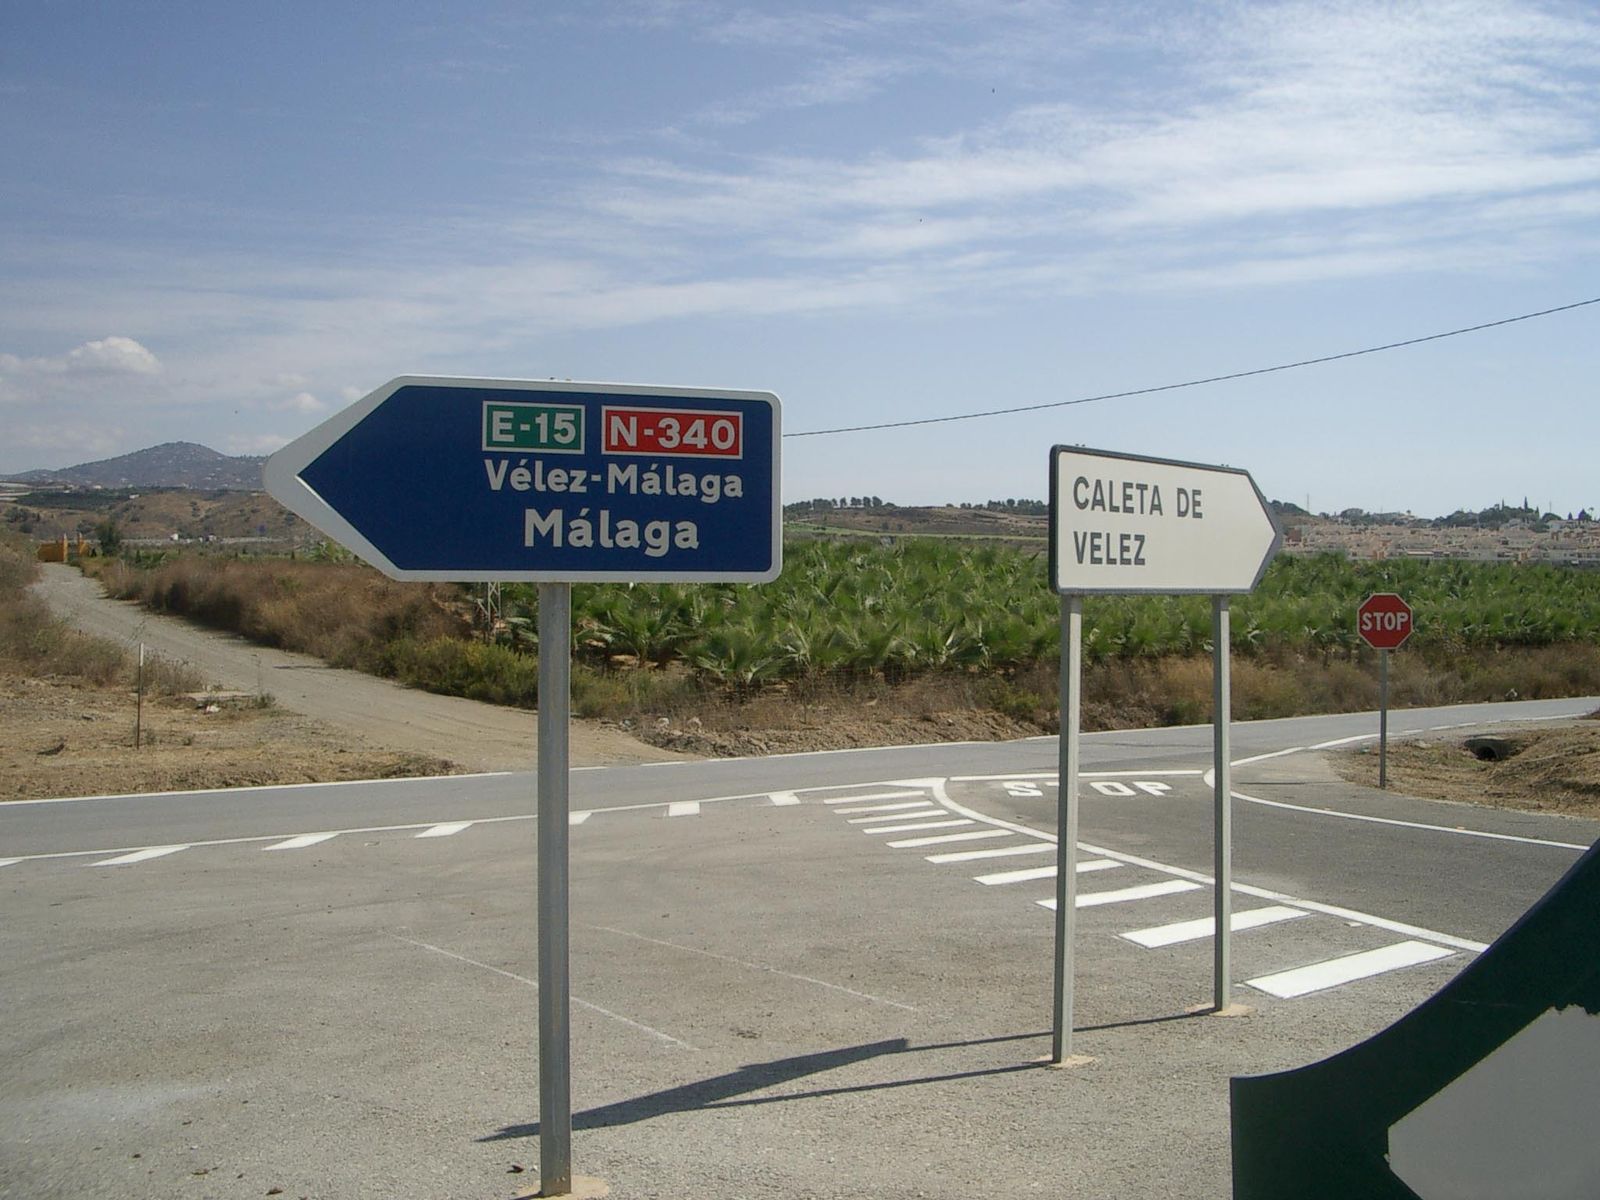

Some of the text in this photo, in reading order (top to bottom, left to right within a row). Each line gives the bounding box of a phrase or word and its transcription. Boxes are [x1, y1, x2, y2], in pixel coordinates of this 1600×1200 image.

[491, 410, 576, 445] E-15
[610, 415, 736, 450] N-340
[484, 458, 744, 505] Vélez-Málaga
[1073, 476, 1203, 519] CALETA DE
[524, 507, 700, 558] Málaga
[1073, 530, 1146, 566] VELEZ
[1361, 611, 1409, 632] STOP
[1002, 780, 1174, 798] SOP
